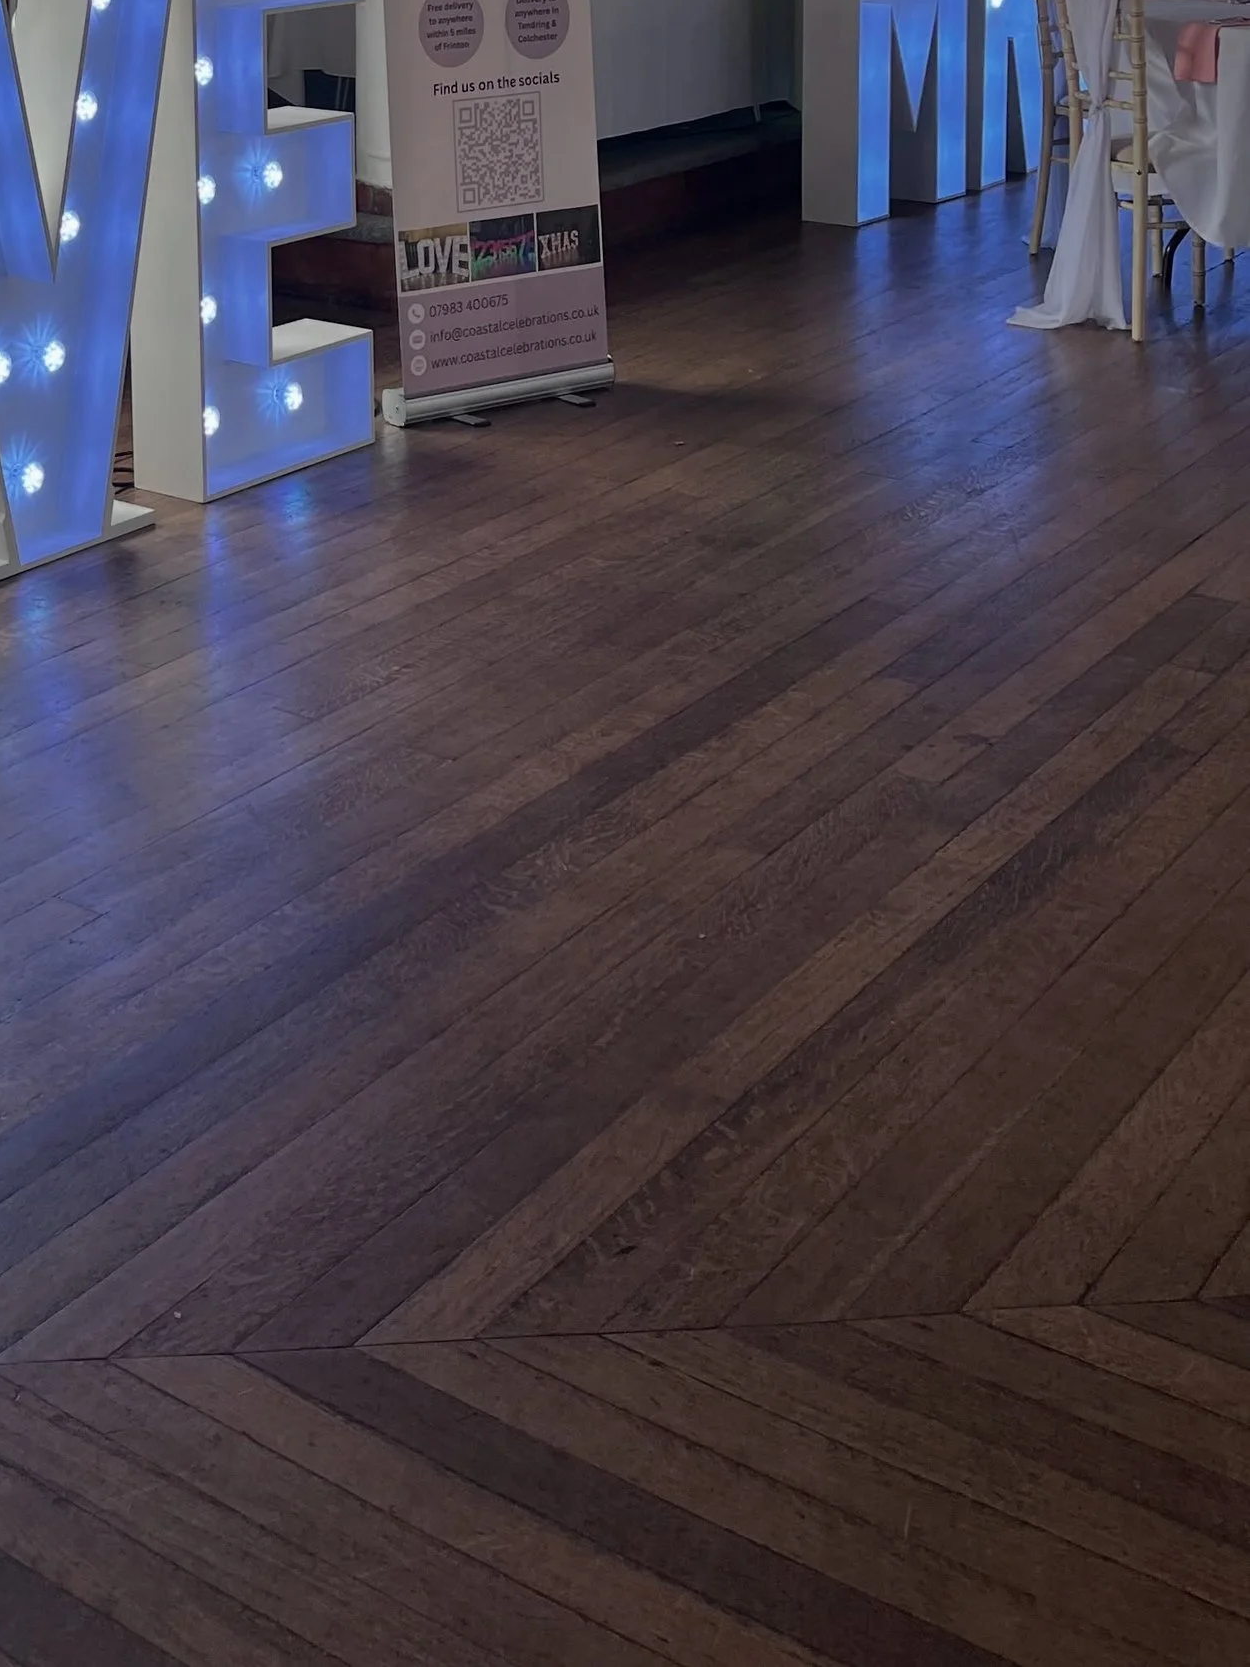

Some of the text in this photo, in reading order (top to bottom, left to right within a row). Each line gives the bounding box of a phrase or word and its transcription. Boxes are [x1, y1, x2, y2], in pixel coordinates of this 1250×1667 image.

[427, 1, 474, 12] Free delivery
[514, 6, 559, 18] anywhere in
[438, 15, 473, 25] anywhere
[518, 20, 550, 30] Tendring
[427, 30, 449, 39] within
[456, 27, 476, 36] miles
[518, 33, 558, 43] Colchester
[434, 42, 442, 51] of
[433, 71, 560, 96] Find us on the socials
[399, 235, 470, 280] LOVE
[429, 294, 509, 318] 07983 400675
[430, 304, 600, 343] info@coastalcelebrations.co.uk
[431, 331, 597, 370] www.coastalcelebrations.co.uk
